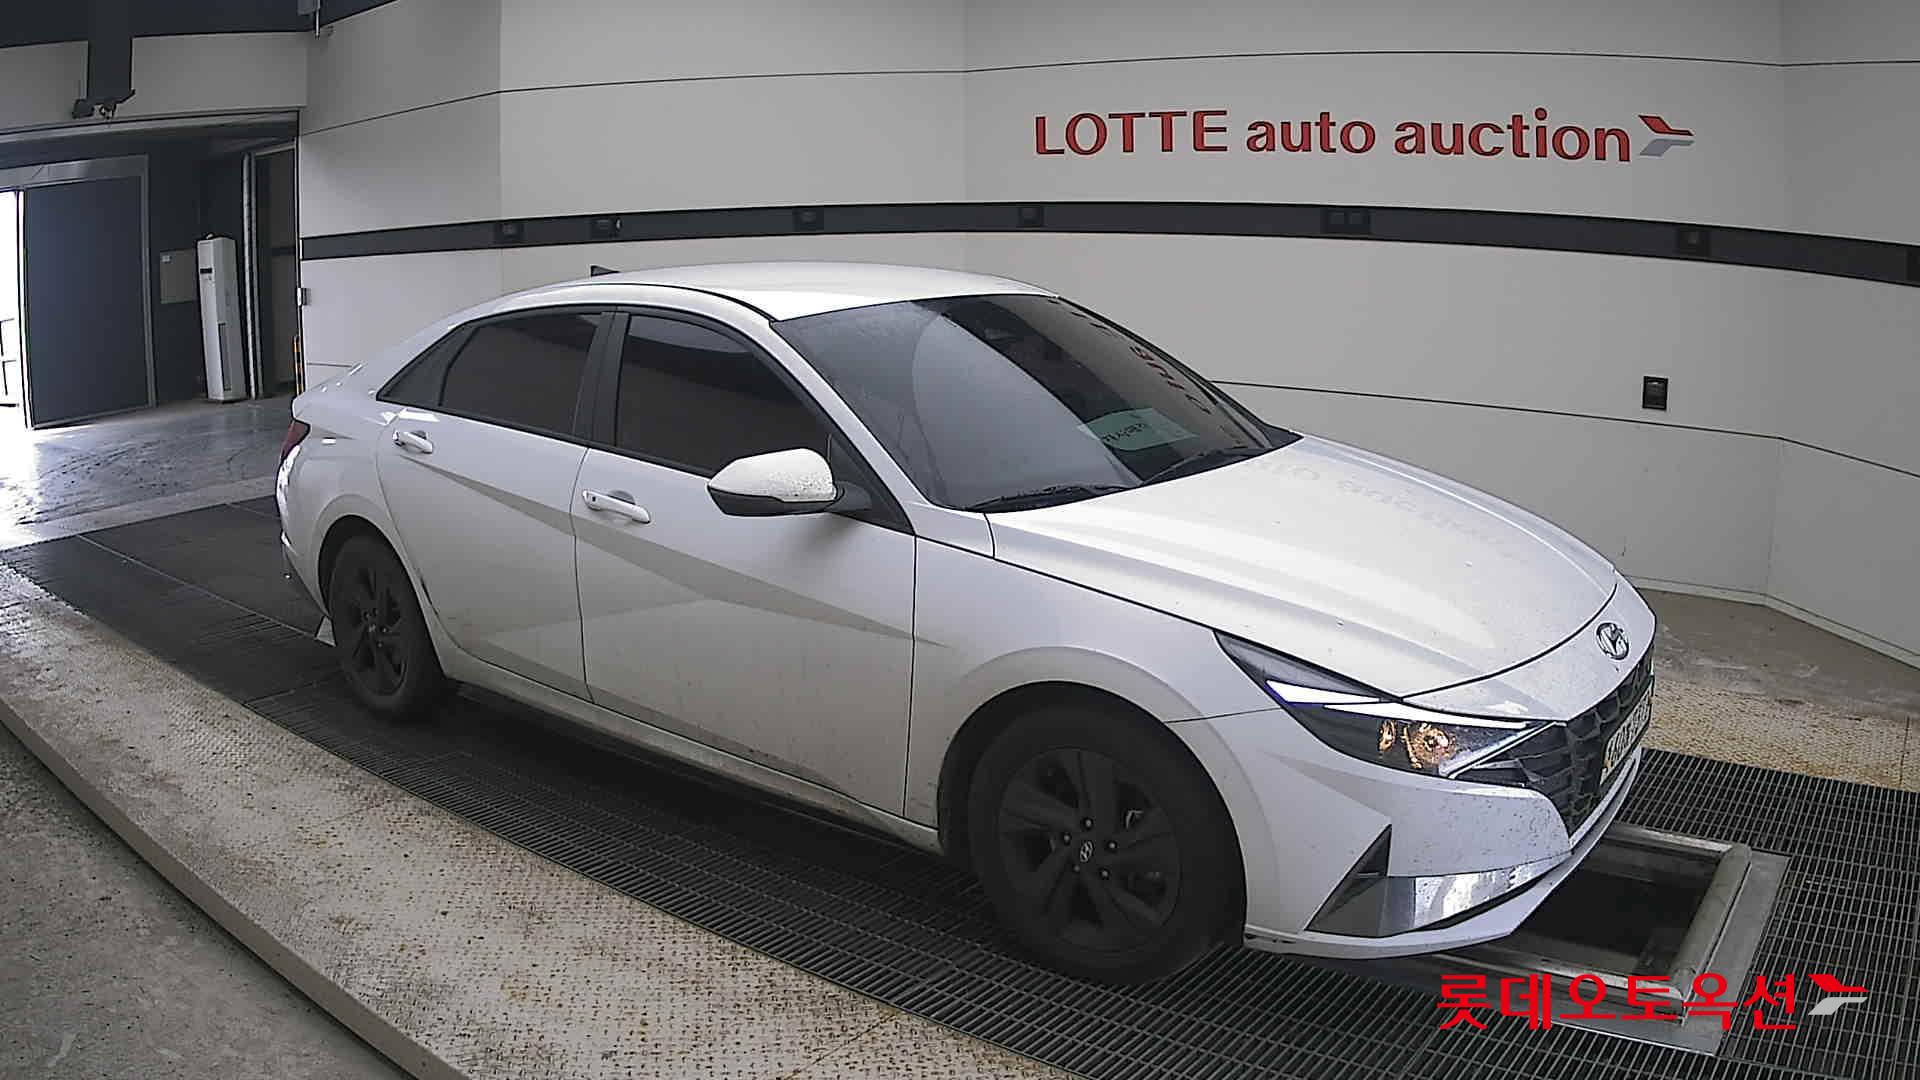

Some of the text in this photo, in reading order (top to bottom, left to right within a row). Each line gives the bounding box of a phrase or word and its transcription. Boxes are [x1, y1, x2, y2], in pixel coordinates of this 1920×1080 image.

[1034, 107, 1632, 162] LOTTE auto auction
